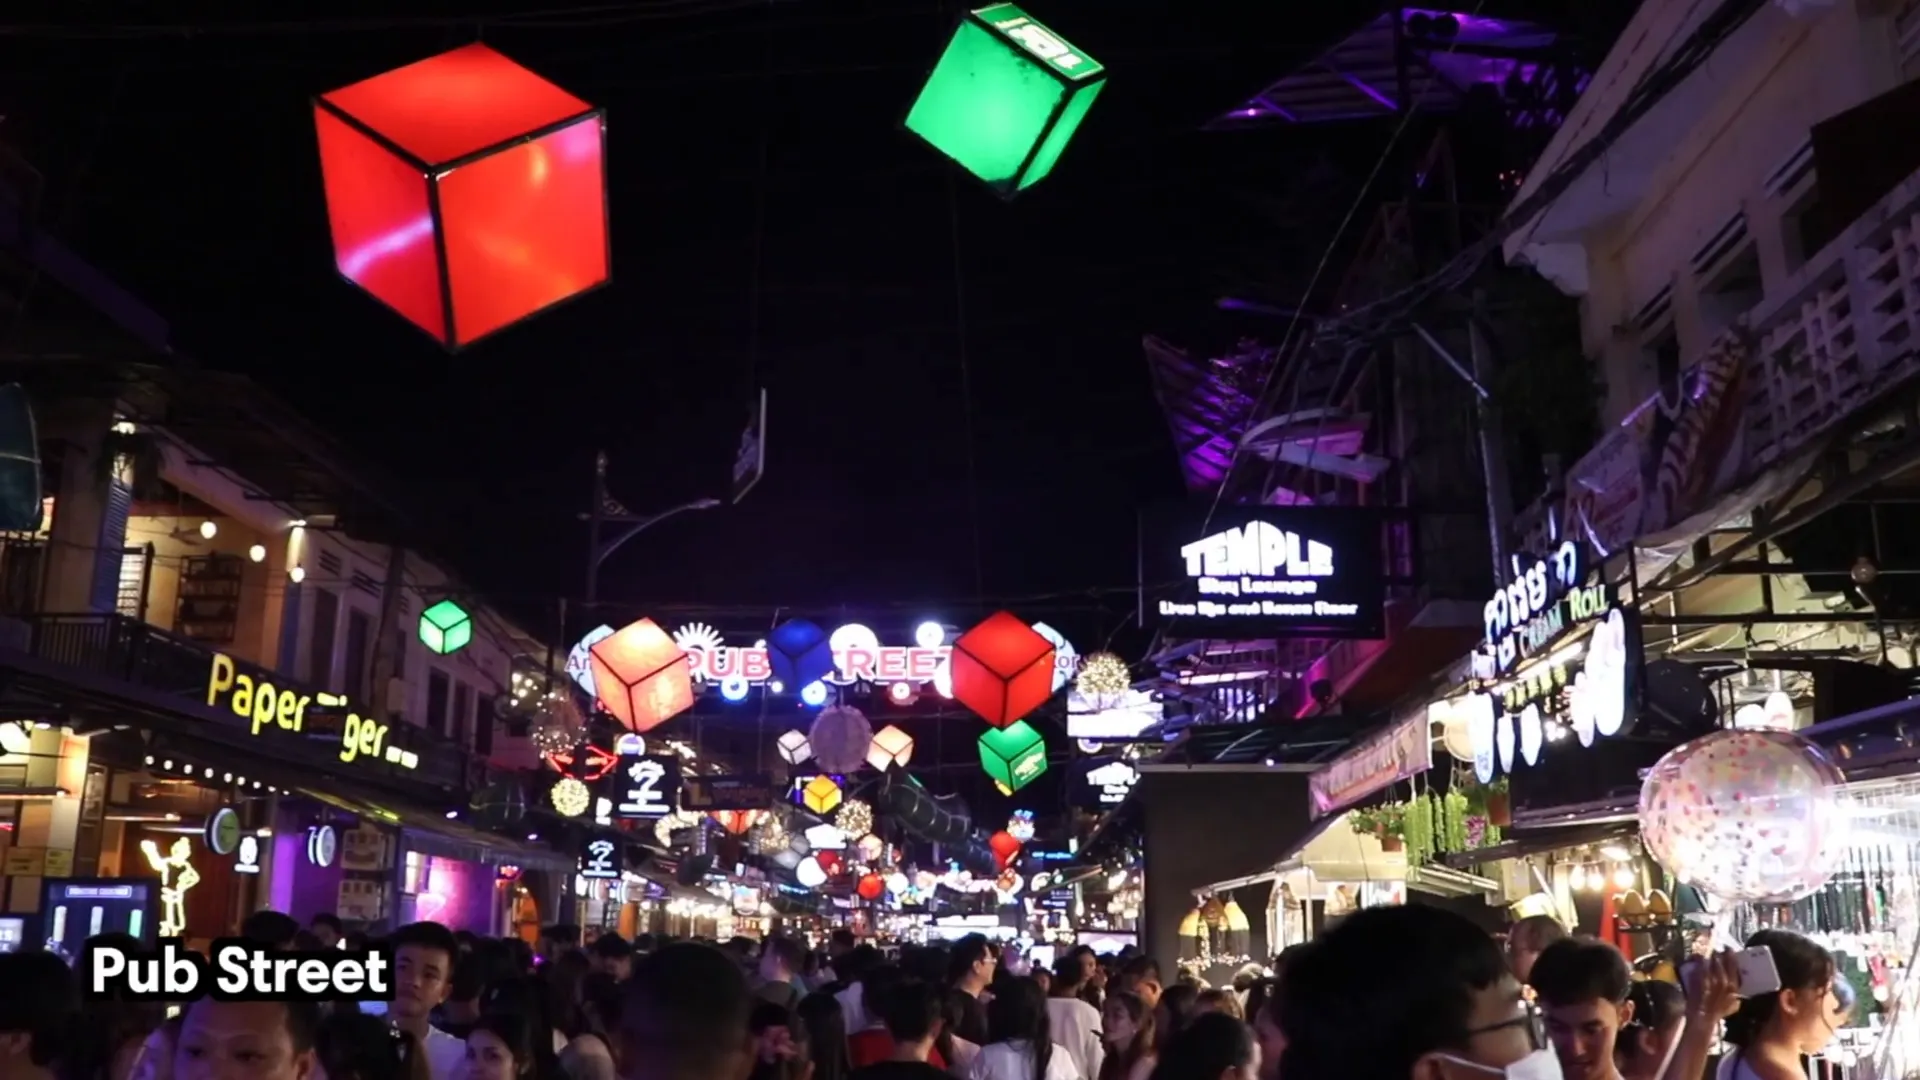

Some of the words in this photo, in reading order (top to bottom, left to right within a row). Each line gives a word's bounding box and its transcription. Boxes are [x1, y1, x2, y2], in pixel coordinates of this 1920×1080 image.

[1181, 520, 1334, 576] TEMPLE
[1569, 584, 1609, 621] ROLL
[687, 647, 773, 681] PUB
[207, 653, 311, 736] Paper
[316, 692, 389, 763] ger
